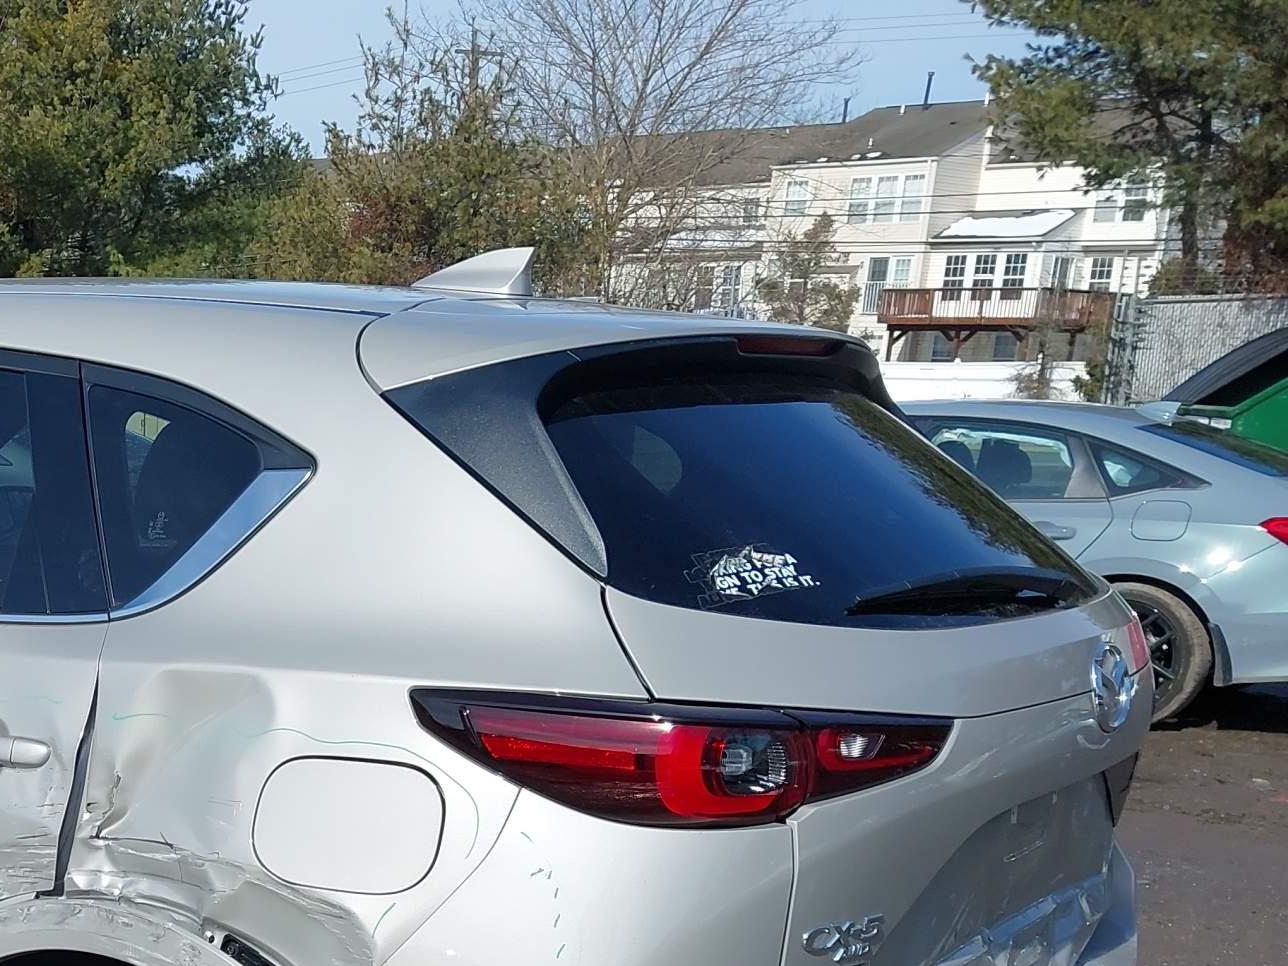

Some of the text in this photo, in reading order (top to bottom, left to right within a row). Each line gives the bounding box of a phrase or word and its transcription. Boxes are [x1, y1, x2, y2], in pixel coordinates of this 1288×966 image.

[740, 570, 764, 584] TO
[764, 564, 798, 580] STAY
[801, 913, 884, 957] CX-5
